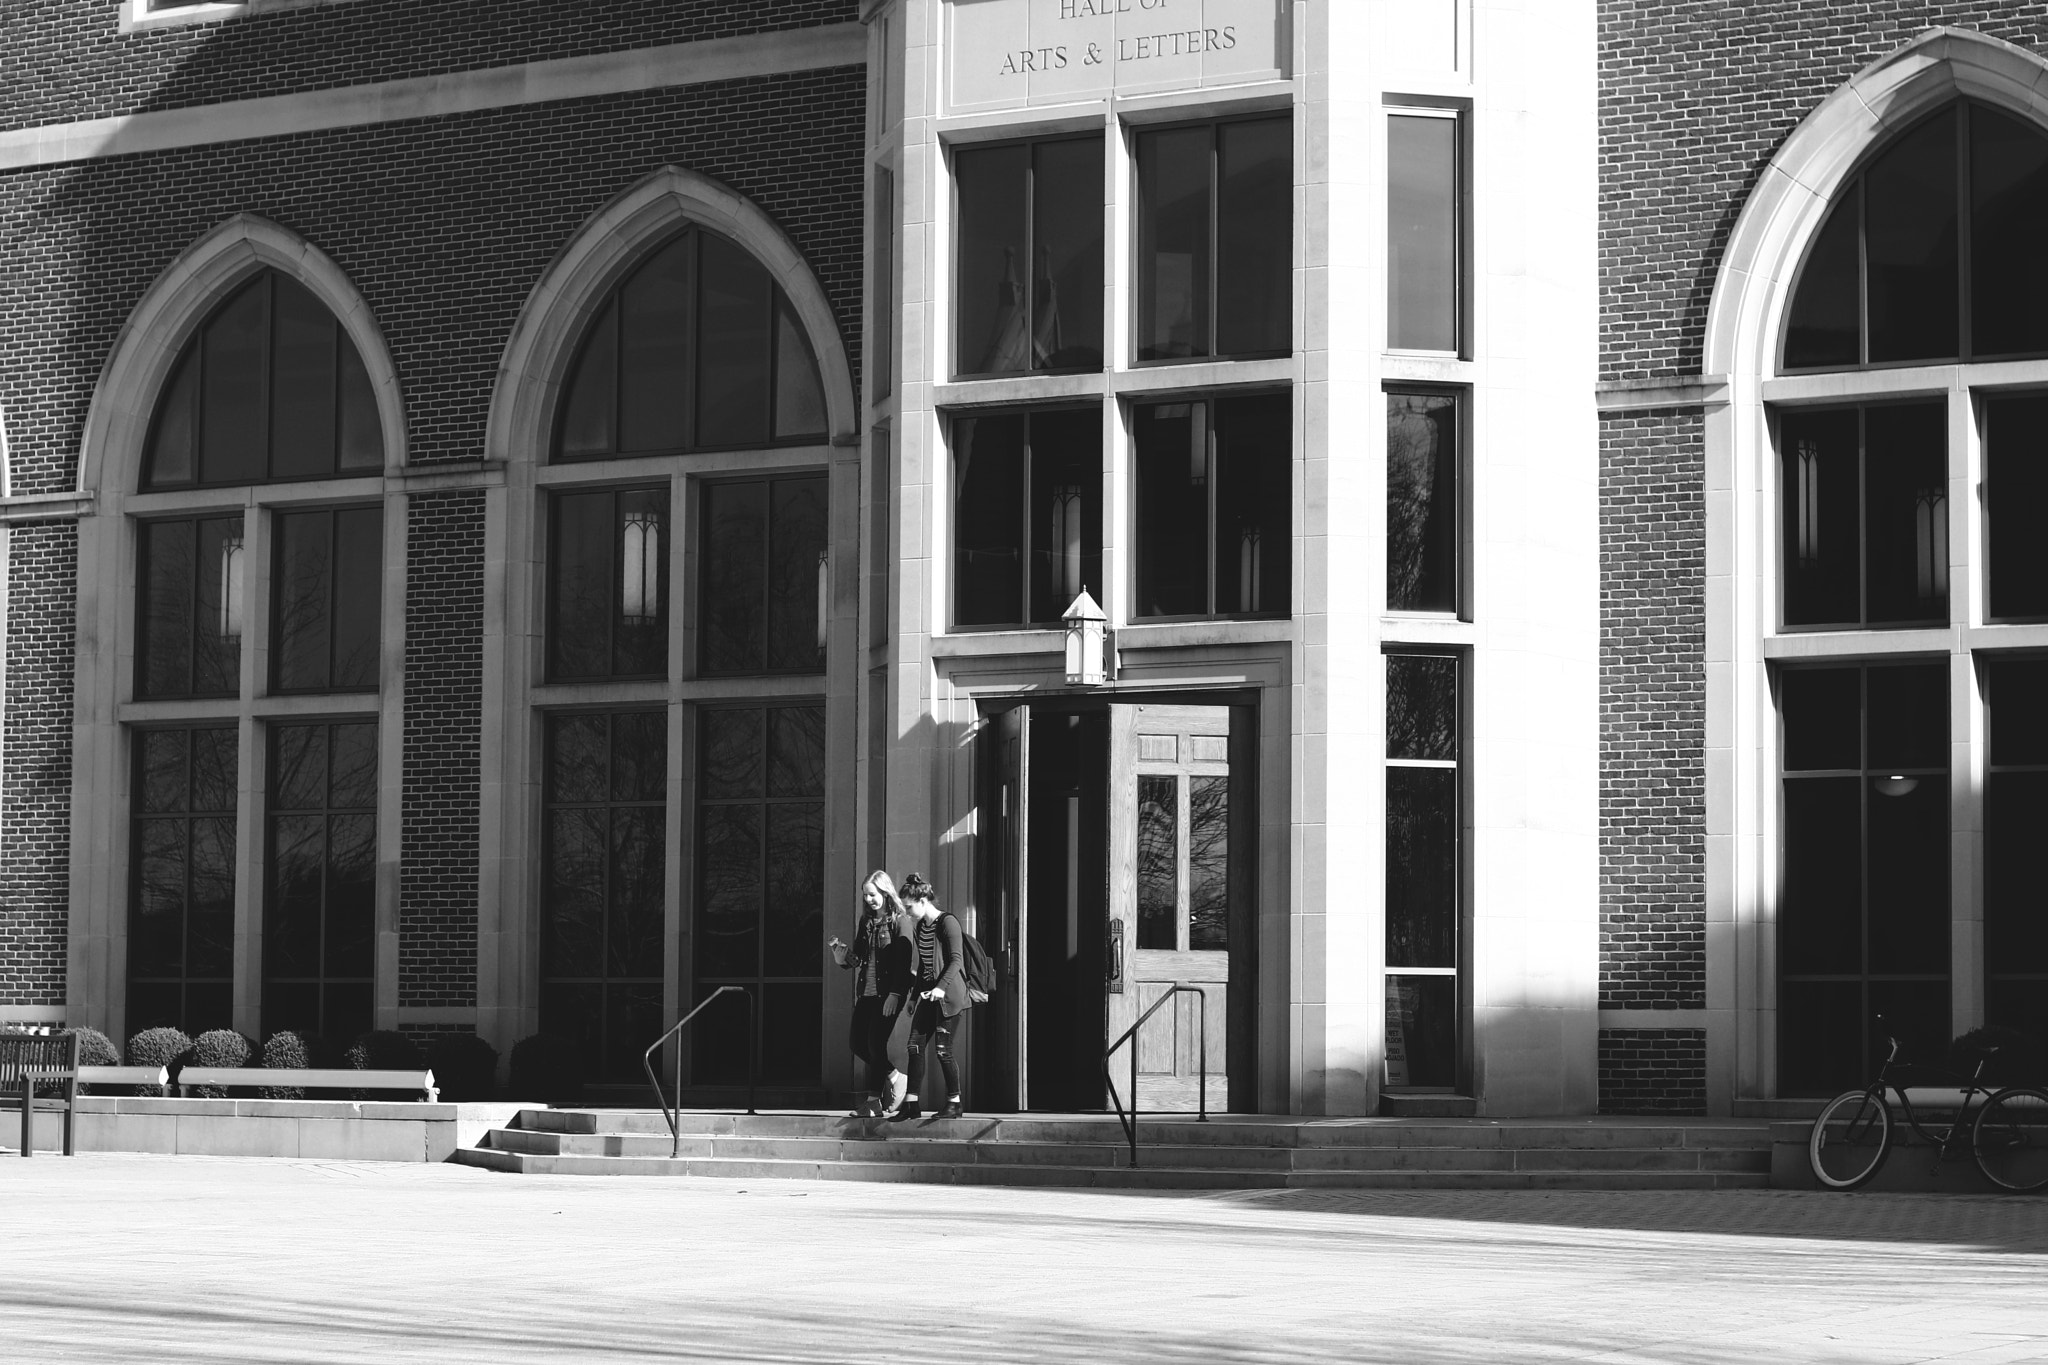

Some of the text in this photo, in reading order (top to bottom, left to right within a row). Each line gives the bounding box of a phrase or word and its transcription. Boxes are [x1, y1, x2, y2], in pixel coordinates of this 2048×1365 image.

[1059, 0, 1131, 19] HALL
[999, 26, 1236, 75] ARTS & LETTERS
